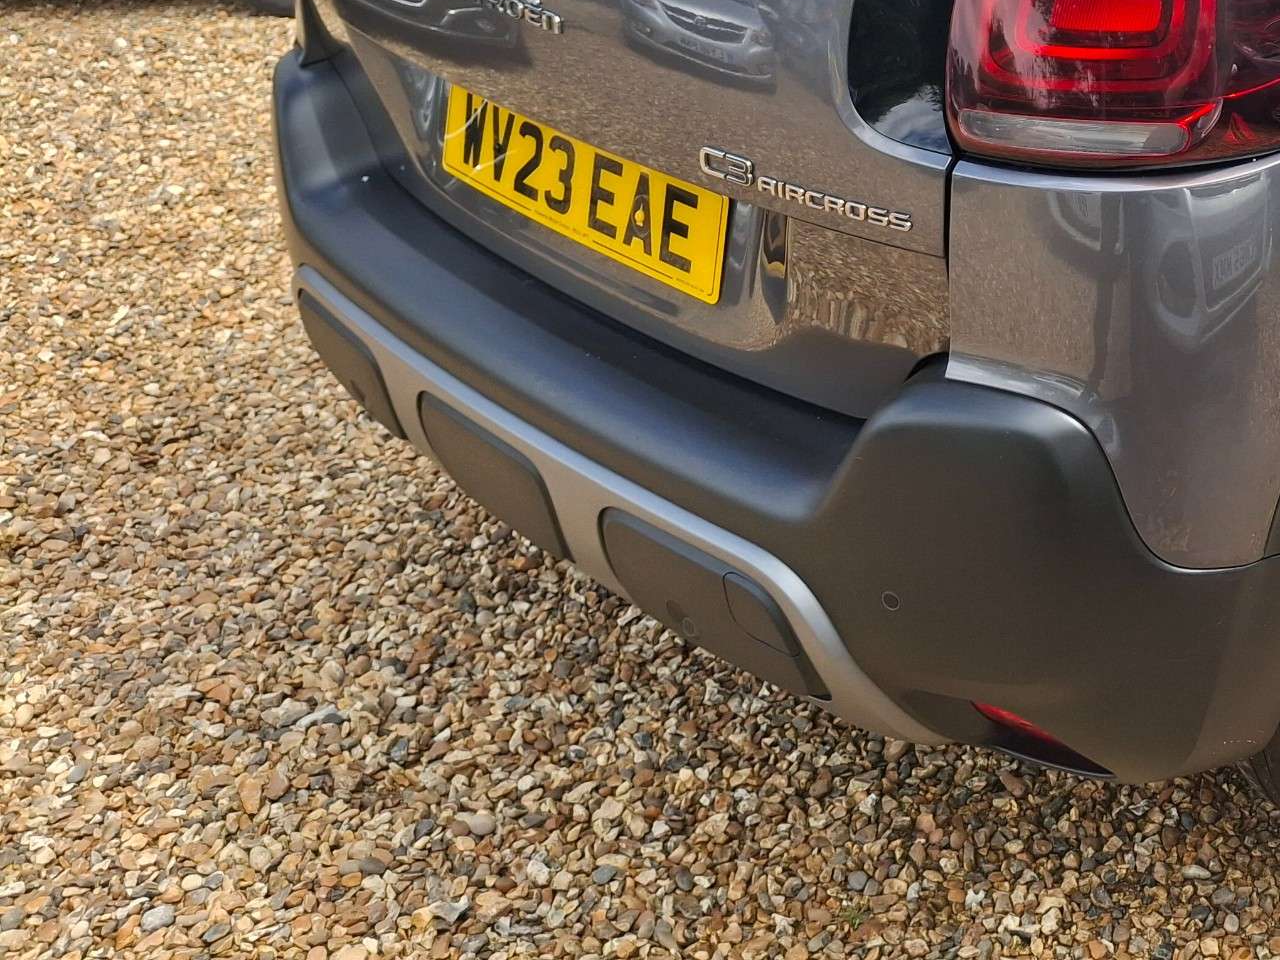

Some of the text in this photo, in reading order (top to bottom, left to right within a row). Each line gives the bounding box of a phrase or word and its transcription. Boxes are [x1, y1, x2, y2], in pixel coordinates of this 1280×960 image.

[462, 92, 700, 274] WV23 EAE
[699, 145, 914, 232] C3 AIRCROSS
